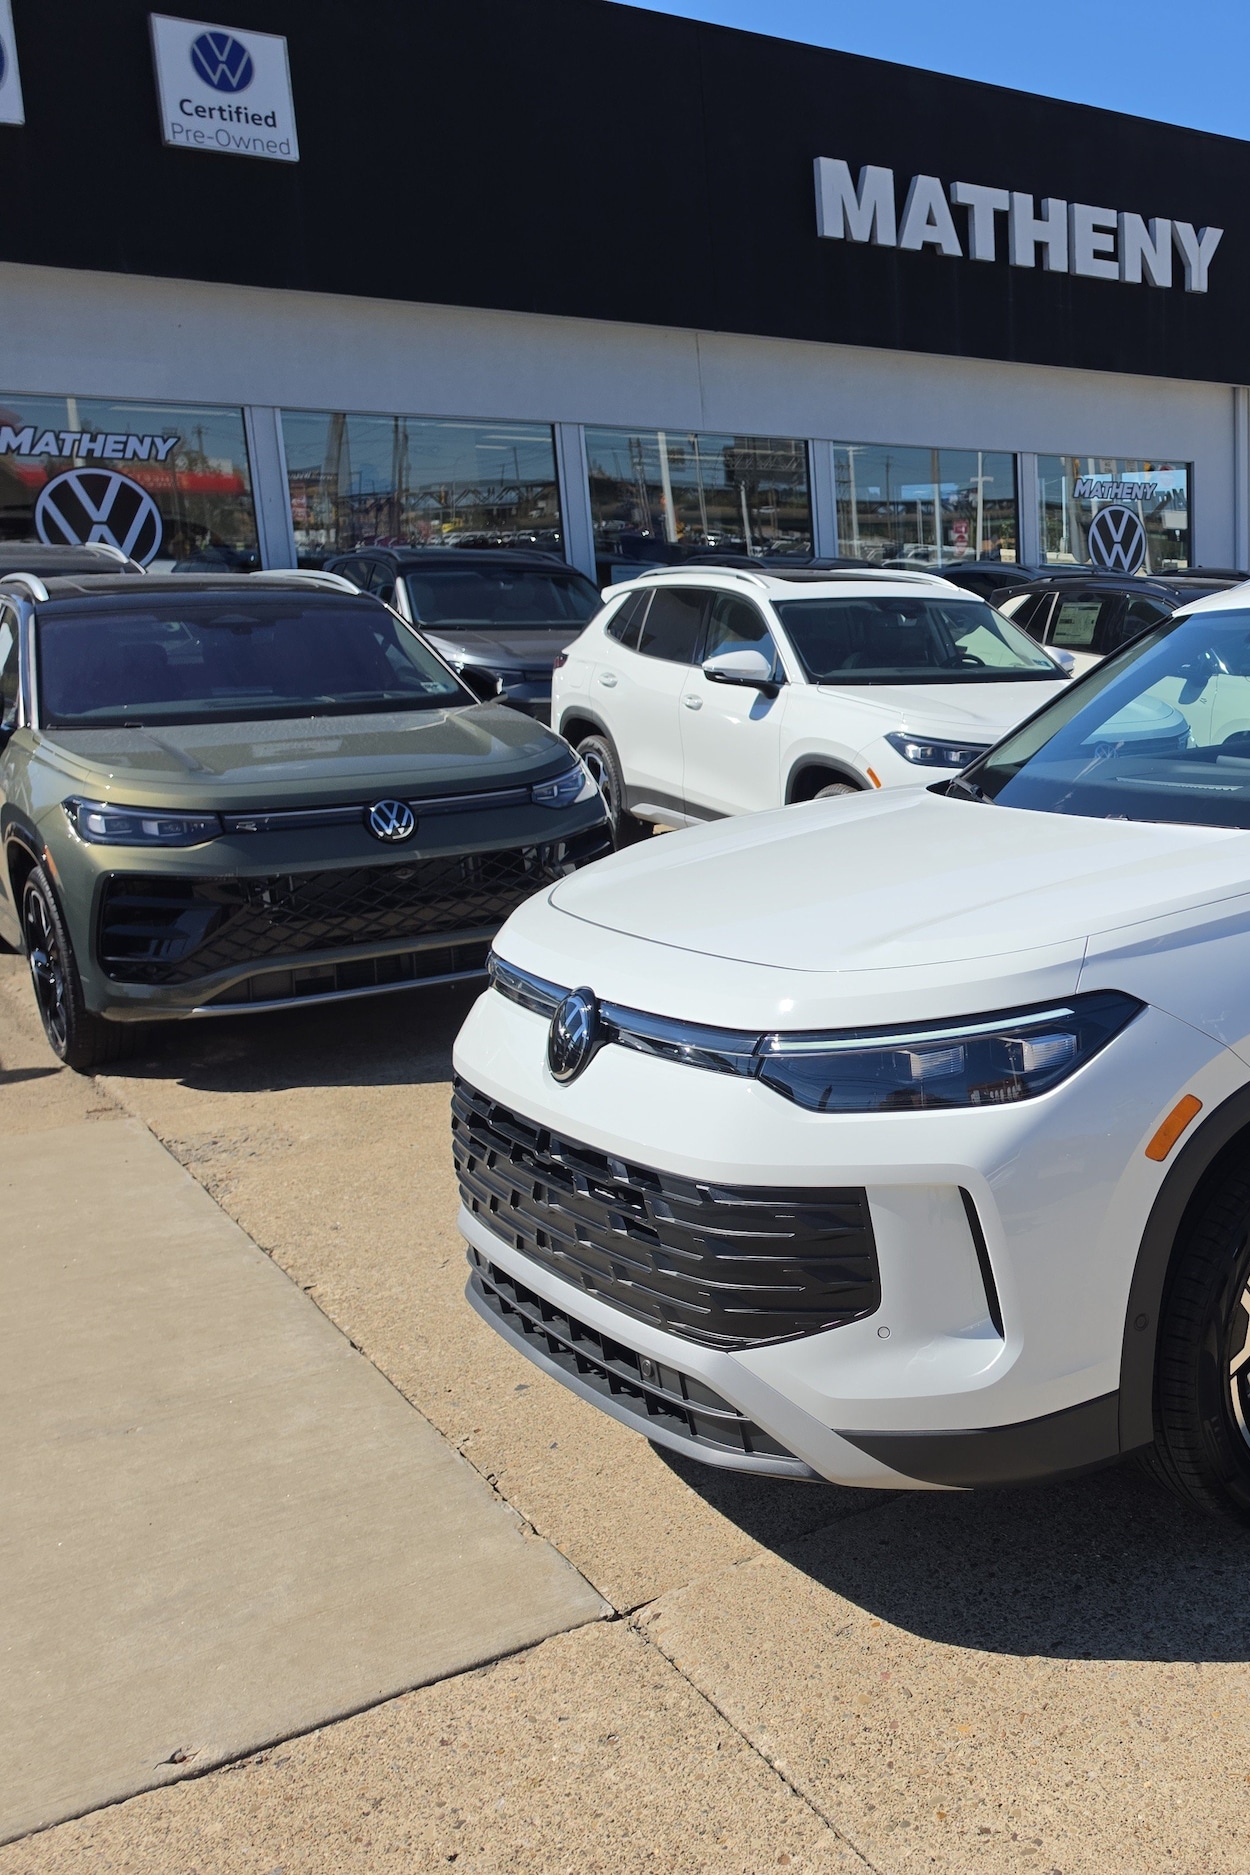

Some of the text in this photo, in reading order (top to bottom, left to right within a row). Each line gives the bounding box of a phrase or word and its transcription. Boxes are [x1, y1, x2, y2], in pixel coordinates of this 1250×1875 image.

[179, 98, 278, 129] Certified
[170, 122, 292, 156] Pre-Owned
[812, 155, 1225, 295] MATHENY
[0, 425, 180, 462] MATHENY
[1073, 477, 1158, 501] MATHENY
